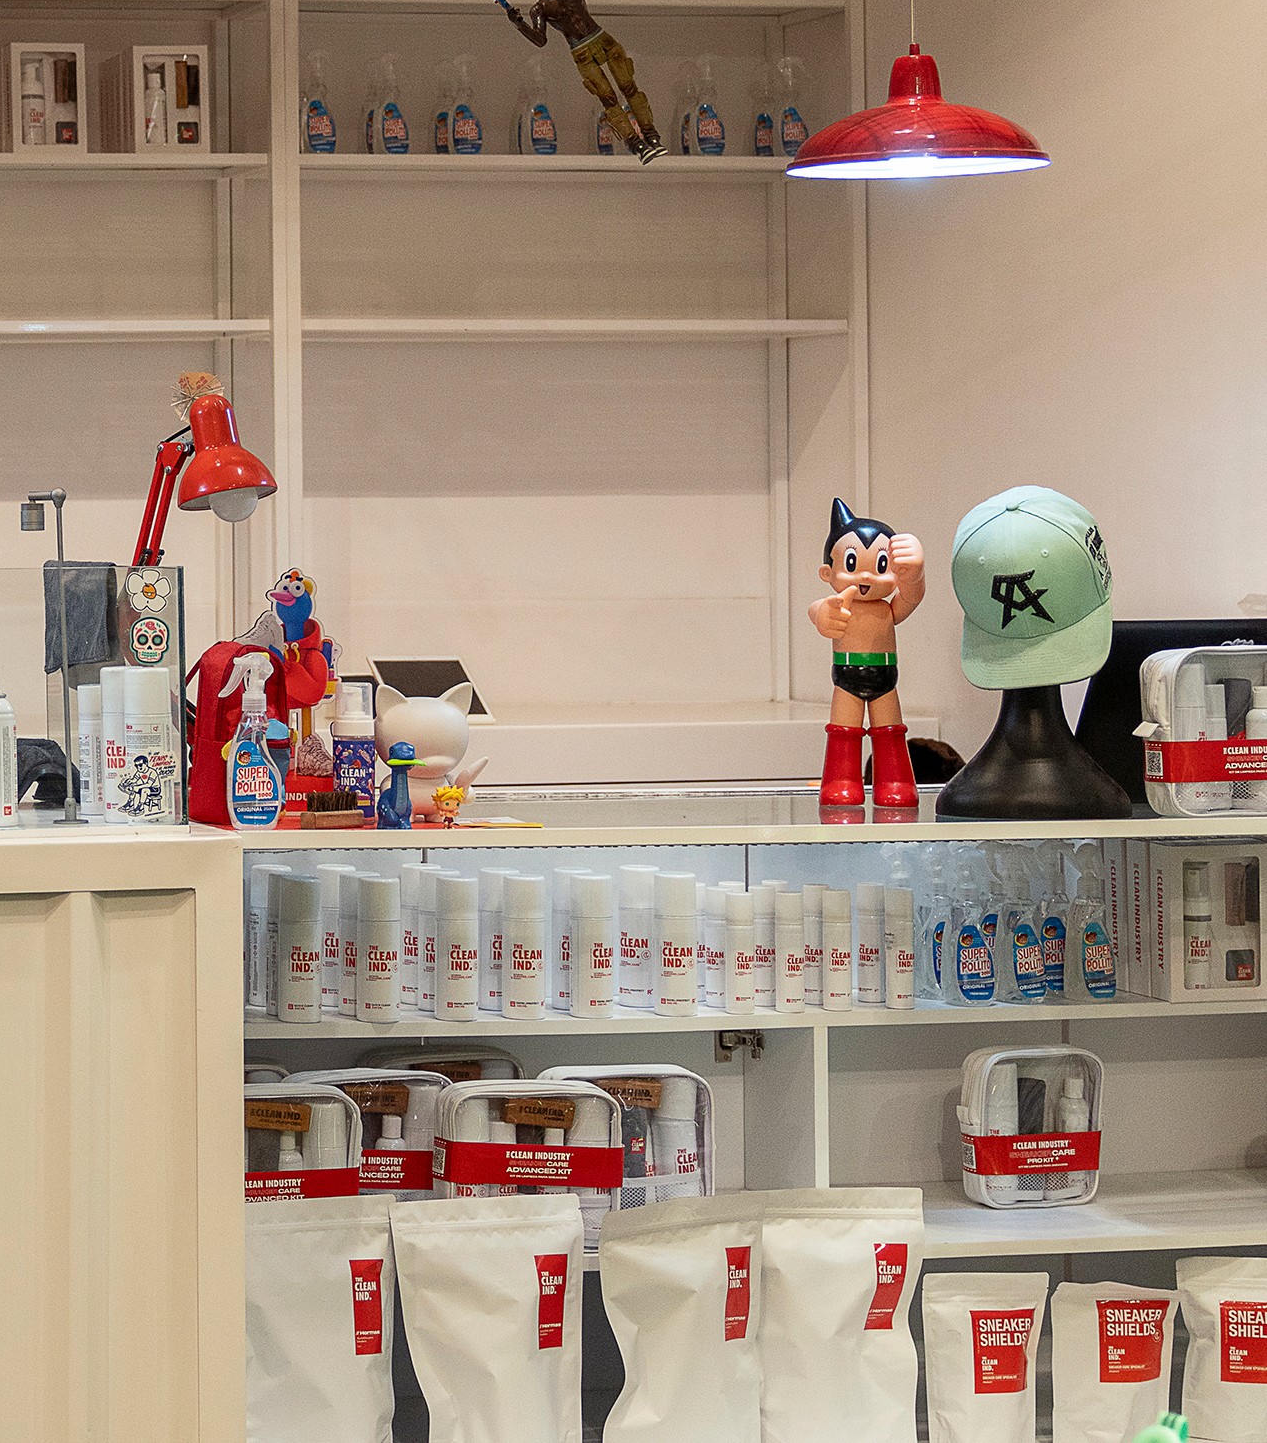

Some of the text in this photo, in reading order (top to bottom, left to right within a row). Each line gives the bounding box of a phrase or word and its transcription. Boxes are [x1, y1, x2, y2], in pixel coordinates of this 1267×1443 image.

[1227, 746, 1249, 755] CLEAN
[238, 766, 268, 780] SUPER
[340, 769, 366, 777] CLEAN
[341, 777, 359, 786] IND.
[237, 780, 272, 794] POLLITO
[1156, 875, 1164, 909] CLEAN
[1133, 869, 1142, 963] CLEAN INDUSTRY
[1111, 899, 1120, 958] INDUSTRY
[620, 938, 649, 948] CLEAN
[368, 951, 398, 961] CLEAN
[512, 949, 542, 960] CLEAN
[593, 948, 613, 958] CLEA
[621, 948, 640, 959] IND.
[662, 947, 693, 957] CLEAN
[755, 948, 776, 956] CLEAN
[859, 947, 879, 955] CLEAN
[961, 947, 988, 961] SUPER
[1190, 949, 1209, 957] IND.
[291, 952, 320, 962] CLEAN
[292, 963, 314, 973] IND.
[368, 962, 391, 972] IND.
[451, 961, 473, 971] IND.
[513, 960, 536, 971] IND.
[593, 959, 612, 969] IND.
[663, 958, 686, 968] IND.
[961, 960, 991, 973] POLLITO
[256, 1109, 303, 1121] CLEAN IND.
[524, 1106, 547, 1116] CLEAN
[1017, 1139, 1069, 1150] CLEAN INDUSTRY
[510, 1151, 571, 1161] CLEAN INDUSTRY
[1051, 1148, 1076, 1156] CARE
[368, 1156, 404, 1165] INDUSTRY
[506, 1166, 557, 1174] ADVANCED
[245, 1178, 302, 1189] LEAN INDUSTRY
[456, 1185, 476, 1197] ND.
[729, 1269, 748, 1280] CLEAN
[878, 1265, 902, 1275] CLEAN
[541, 1276, 563, 1286] CLEAN
[729, 1279, 743, 1289] IND.
[878, 1275, 895, 1284] IND.
[354, 1282, 377, 1291] CLEAN
[542, 1286, 557, 1295] IND.
[355, 1291, 373, 1301] IND.
[1106, 1309, 1163, 1322] SNEAKER
[1228, 1310, 1267, 1324] SNEA
[979, 1318, 1031, 1332] SNEAKER
[1107, 1322, 1156, 1336] SHIELDS
[1228, 1324, 1267, 1338] SHIEL
[980, 1332, 1028, 1347] SHIELDS
